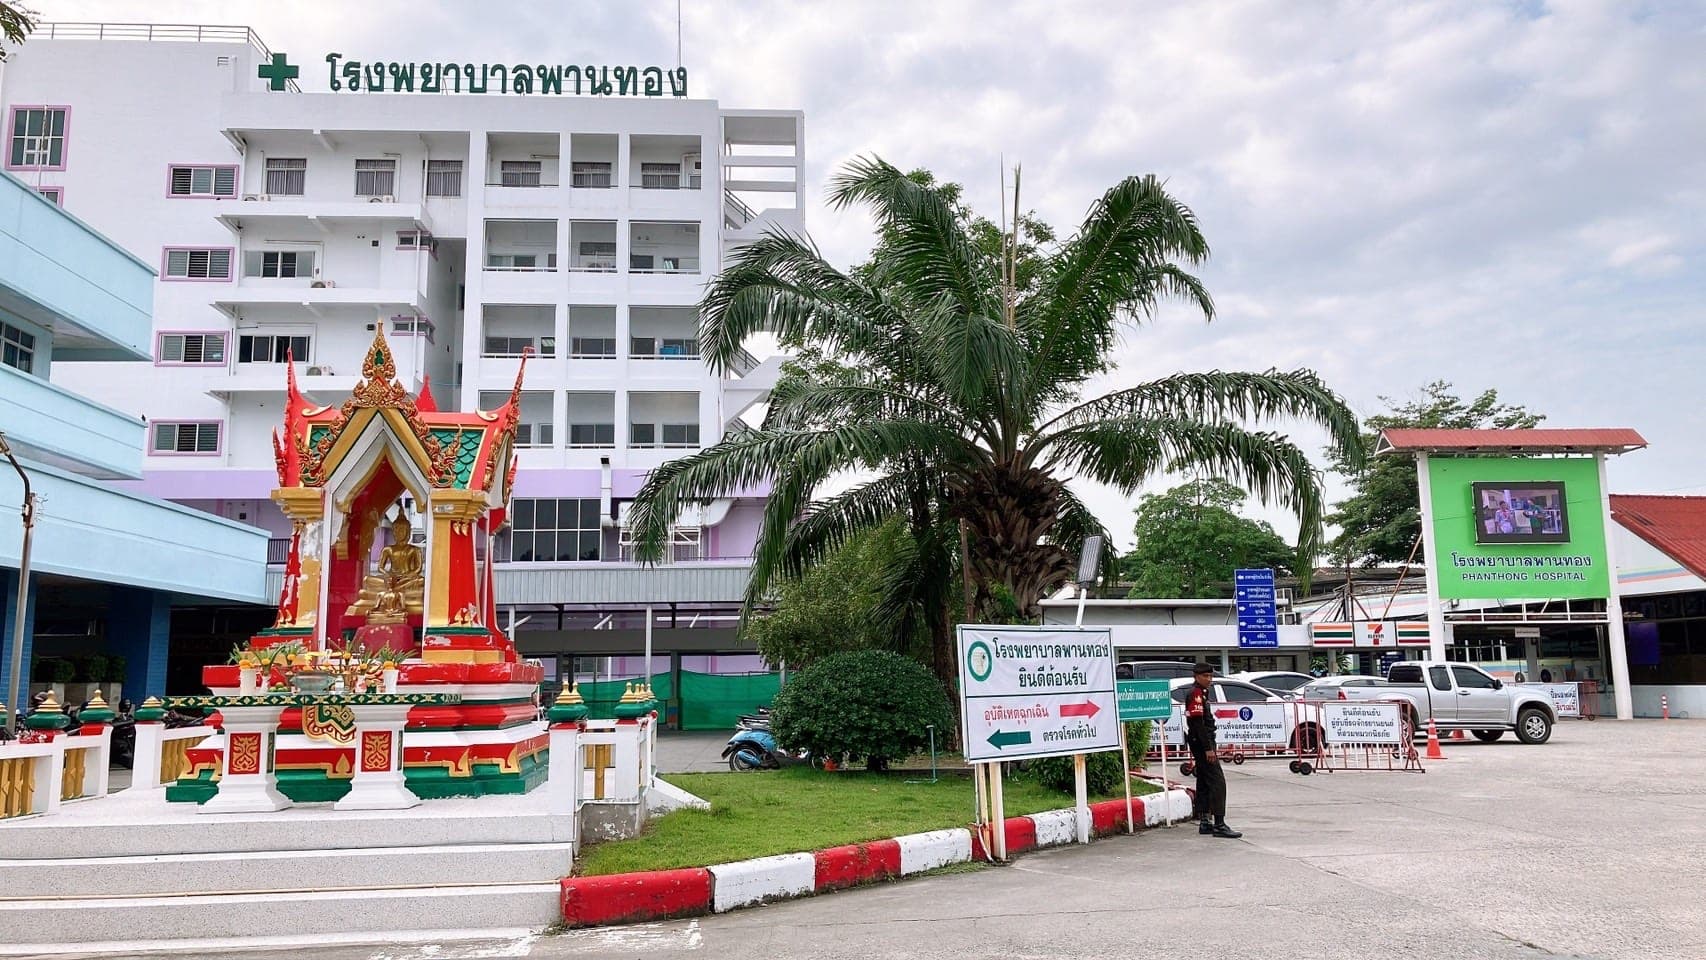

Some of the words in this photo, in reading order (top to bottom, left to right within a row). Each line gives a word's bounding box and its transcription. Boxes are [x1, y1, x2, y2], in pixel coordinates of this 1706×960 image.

[325, 53, 688, 97] โรงพยาบาลพานทอง
[1451, 552, 1592, 567] โรงพยาบาลพานทอง
[1462, 572, 1528, 581] PHANTHONG
[1534, 572, 1586, 581] HOSPITAL
[993, 637, 1109, 659] โรงพยาบาลพานทอง
[1018, 664, 1088, 688] ยินดีต้อนรับ
[984, 703, 1050, 727] อุบัติเหตุฉุกเฉิน
[1042, 720, 1097, 742] ตรวจโรคทั่วไป
